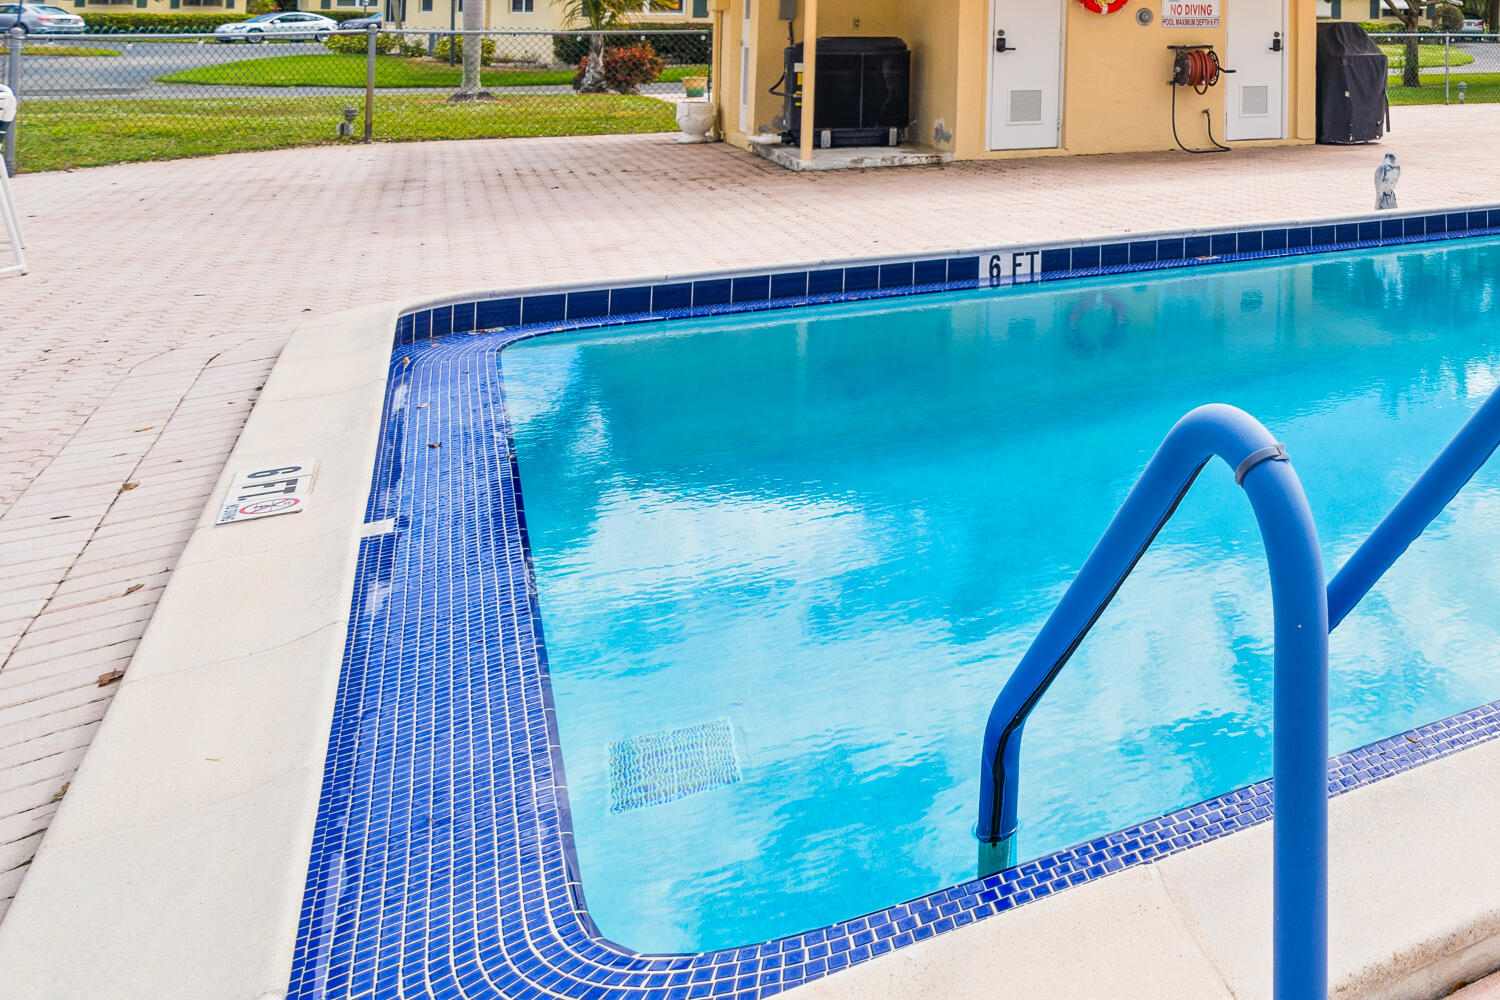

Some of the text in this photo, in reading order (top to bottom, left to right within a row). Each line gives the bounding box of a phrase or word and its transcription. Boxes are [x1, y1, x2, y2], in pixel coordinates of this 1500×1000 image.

[1170, 4, 1212, 16] NO DIVING
[989, 250, 1040, 287] 6 FT
[247, 466, 302, 479] 6
